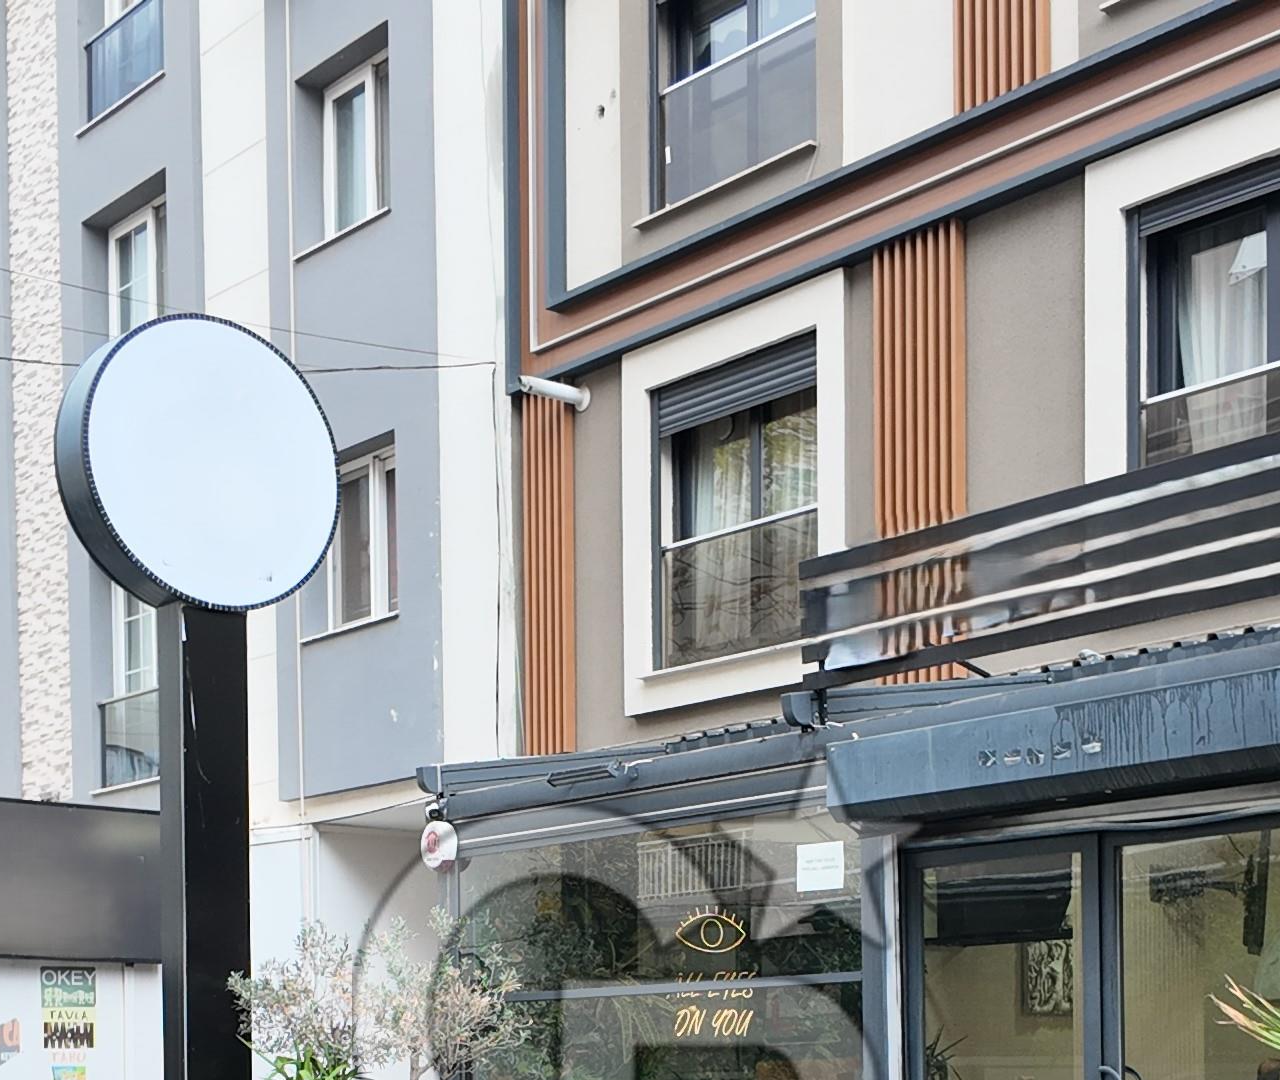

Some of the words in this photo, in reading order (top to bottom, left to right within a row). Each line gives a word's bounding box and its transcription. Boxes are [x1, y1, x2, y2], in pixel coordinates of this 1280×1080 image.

[42, 969, 96, 987] OKEY
[674, 1008, 707, 1037] ON
[711, 1008, 754, 1037] YOU
